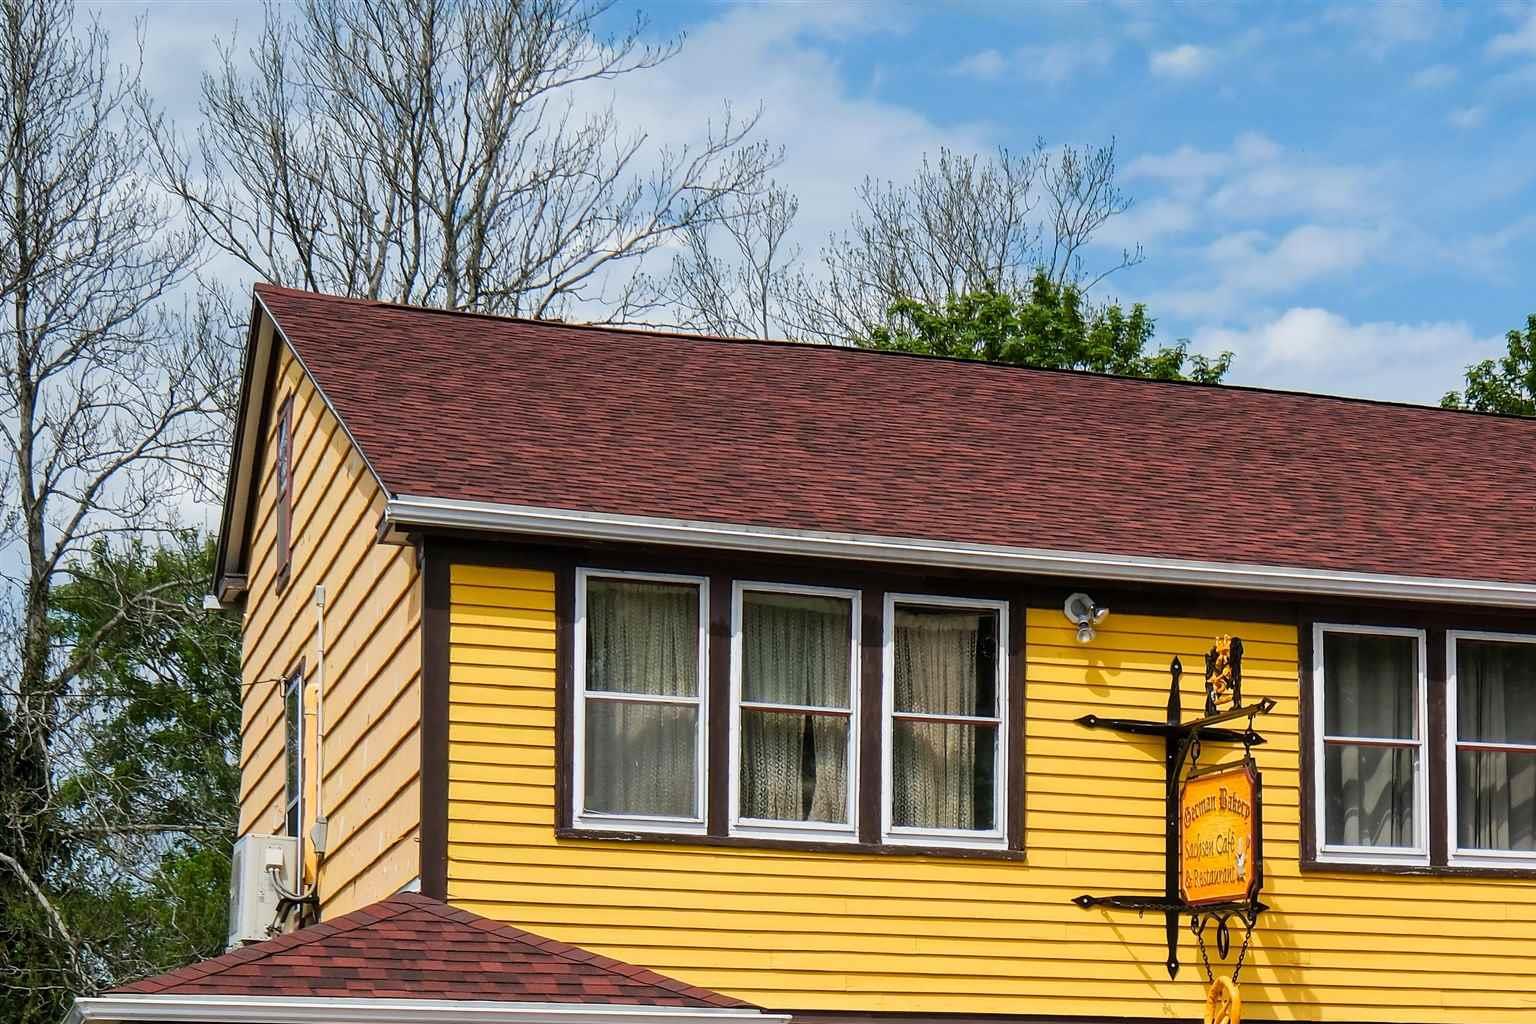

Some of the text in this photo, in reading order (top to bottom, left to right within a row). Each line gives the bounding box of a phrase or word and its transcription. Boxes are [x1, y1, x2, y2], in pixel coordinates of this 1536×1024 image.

[1184, 787, 1251, 829] German Bakery
[1184, 870, 1193, 889] &
